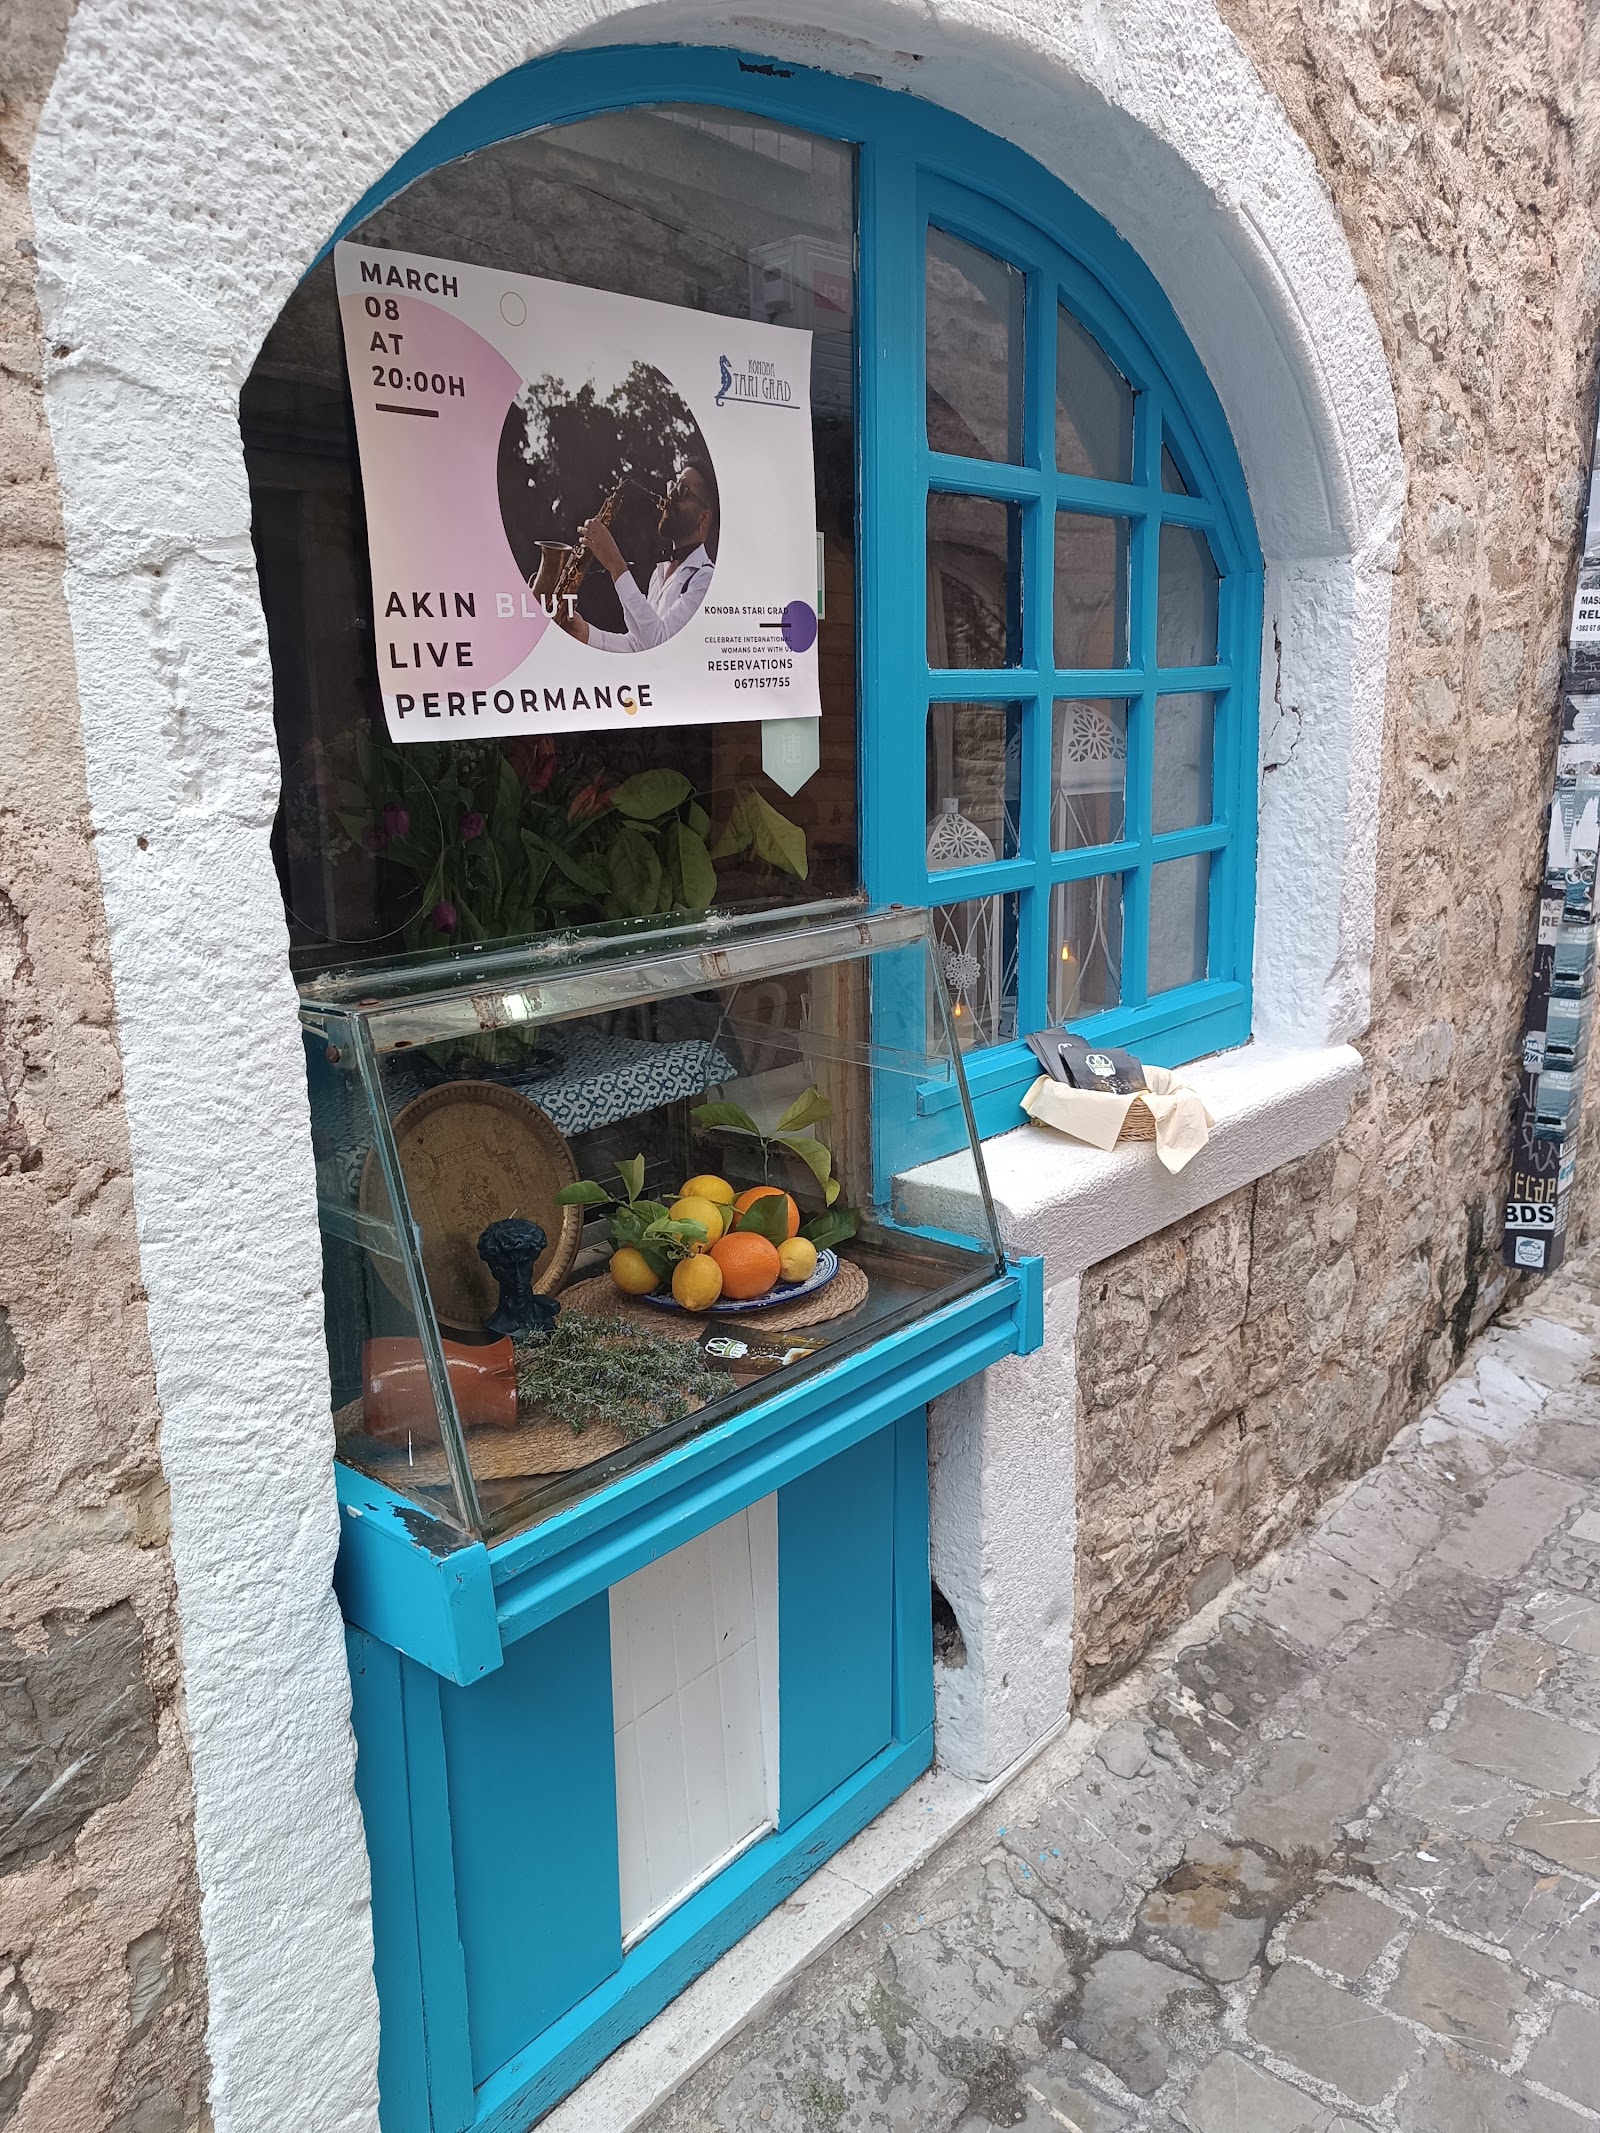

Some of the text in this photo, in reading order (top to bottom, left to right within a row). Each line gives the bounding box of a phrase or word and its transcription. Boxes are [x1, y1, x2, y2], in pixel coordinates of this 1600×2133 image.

[360, 260, 459, 297] MARCH
[364, 296, 400, 320] 08
[370, 331, 403, 355] AT
[372, 365, 465, 397] 20:00H
[762, 377, 791, 402] GRAD
[385, 591, 578, 620] AKIN BLUT
[704, 606, 789, 615] KONOBA STARI GRAD
[704, 636, 742, 644] CELEBRATE
[721, 646, 751, 654] WOMANS
[389, 642, 474, 669] LIVE
[708, 659, 793, 671] RESERVATIONS
[734, 677, 790, 689] 067157755
[395, 684, 653, 719] PERFORMANCE
[1506, 1205, 1554, 1223] BDS
